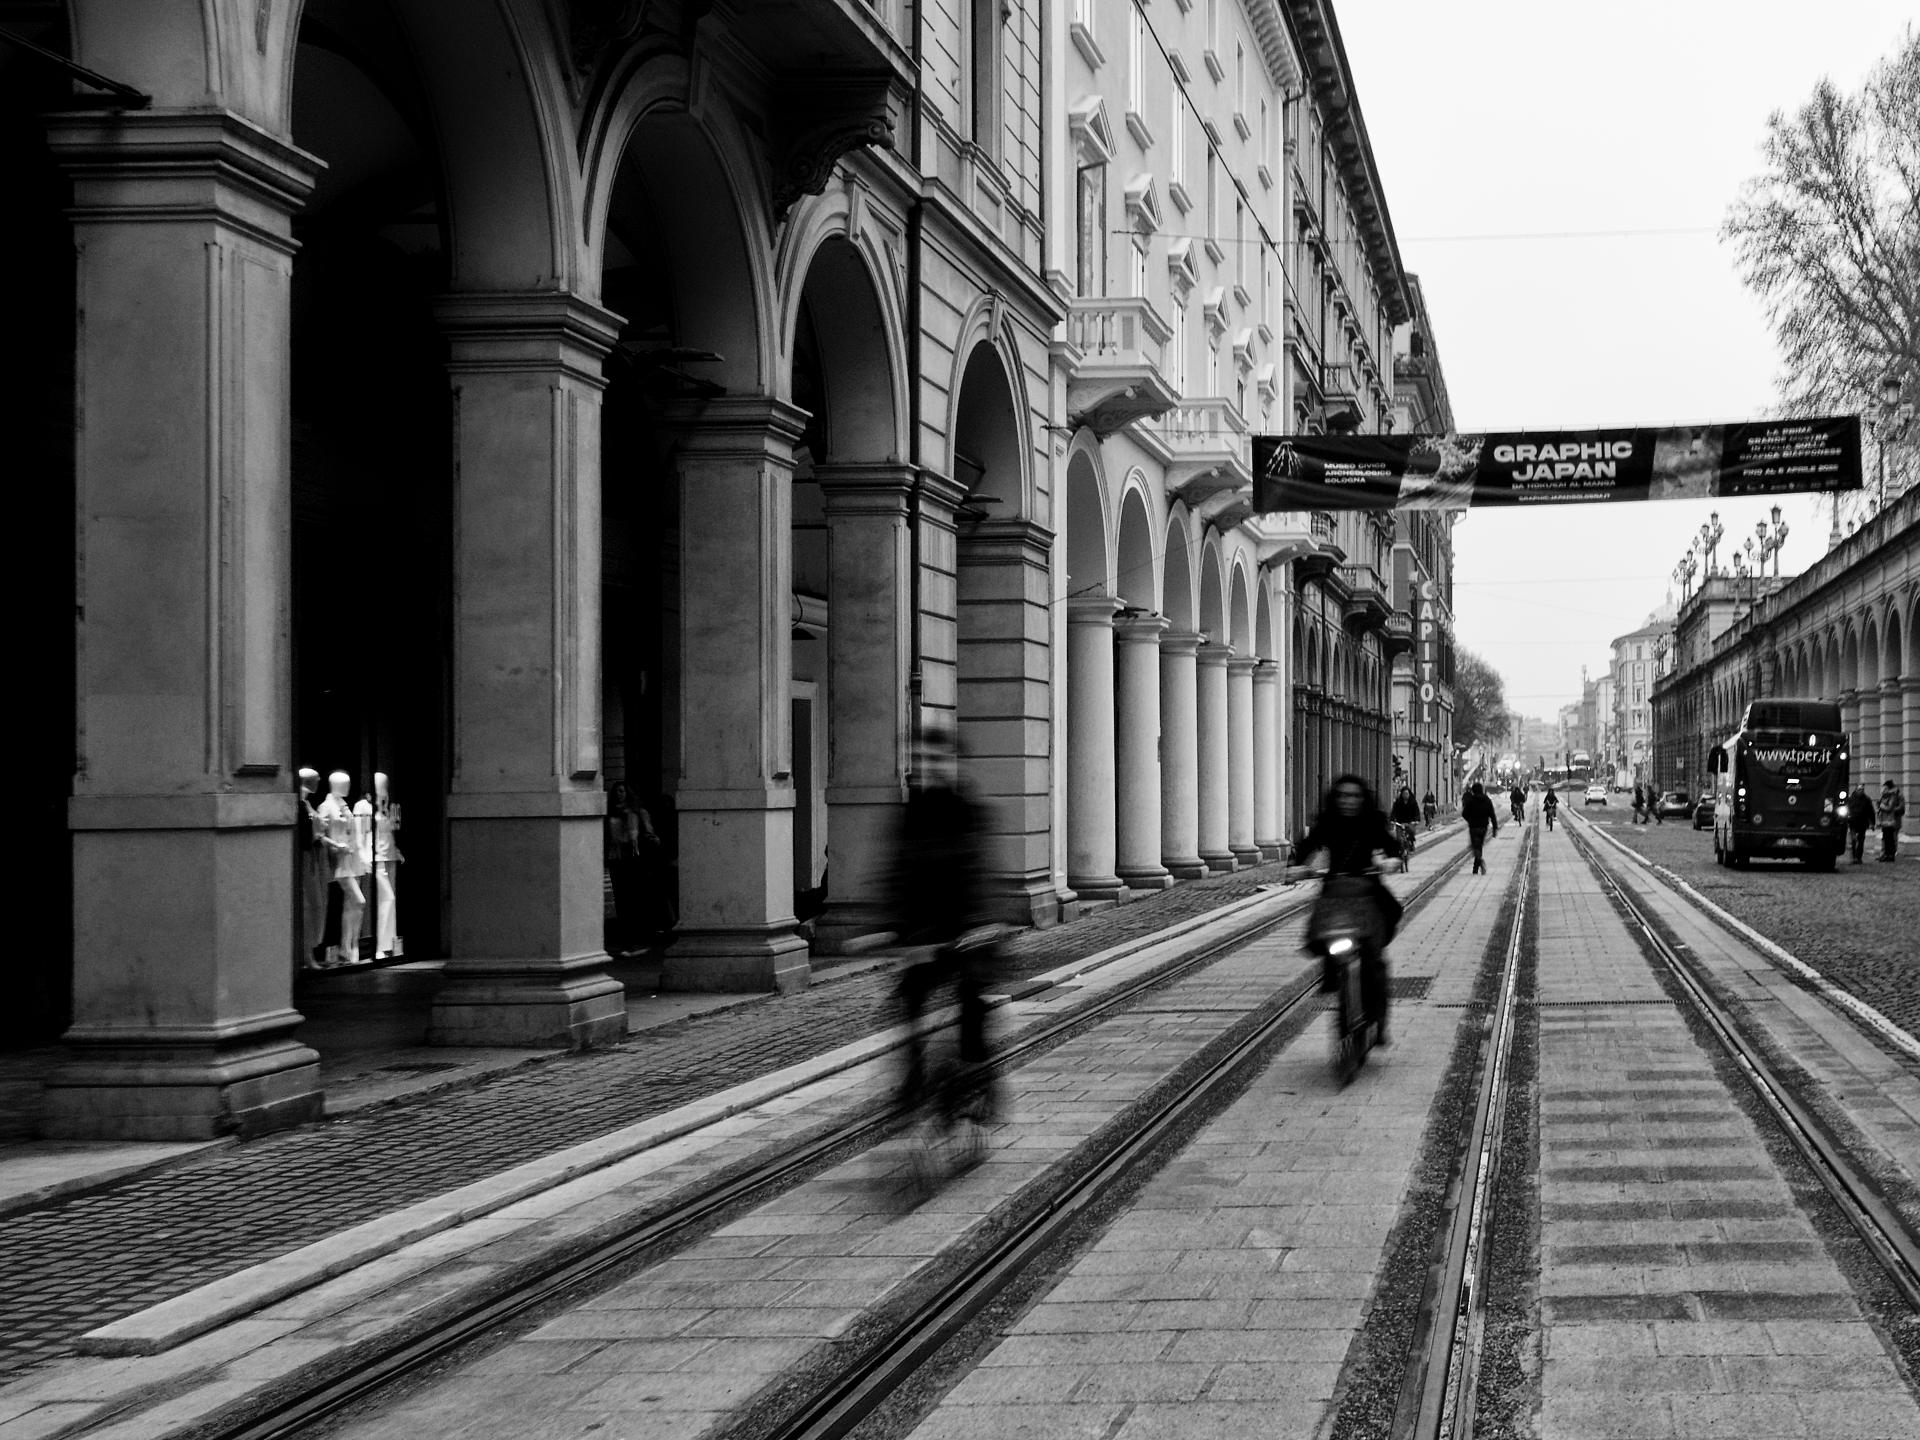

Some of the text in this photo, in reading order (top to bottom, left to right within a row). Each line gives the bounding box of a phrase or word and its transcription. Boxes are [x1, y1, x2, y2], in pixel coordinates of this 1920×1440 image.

[1782, 426, 1812, 435] PRIMA
[1494, 440, 1632, 462] GRAPHIC
[1512, 460, 1616, 482] JAPAN
[1786, 465, 1816, 474] APRILE
[1420, 580, 1434, 723] CAPITOL
[1754, 748, 1832, 766] www.tper.it
